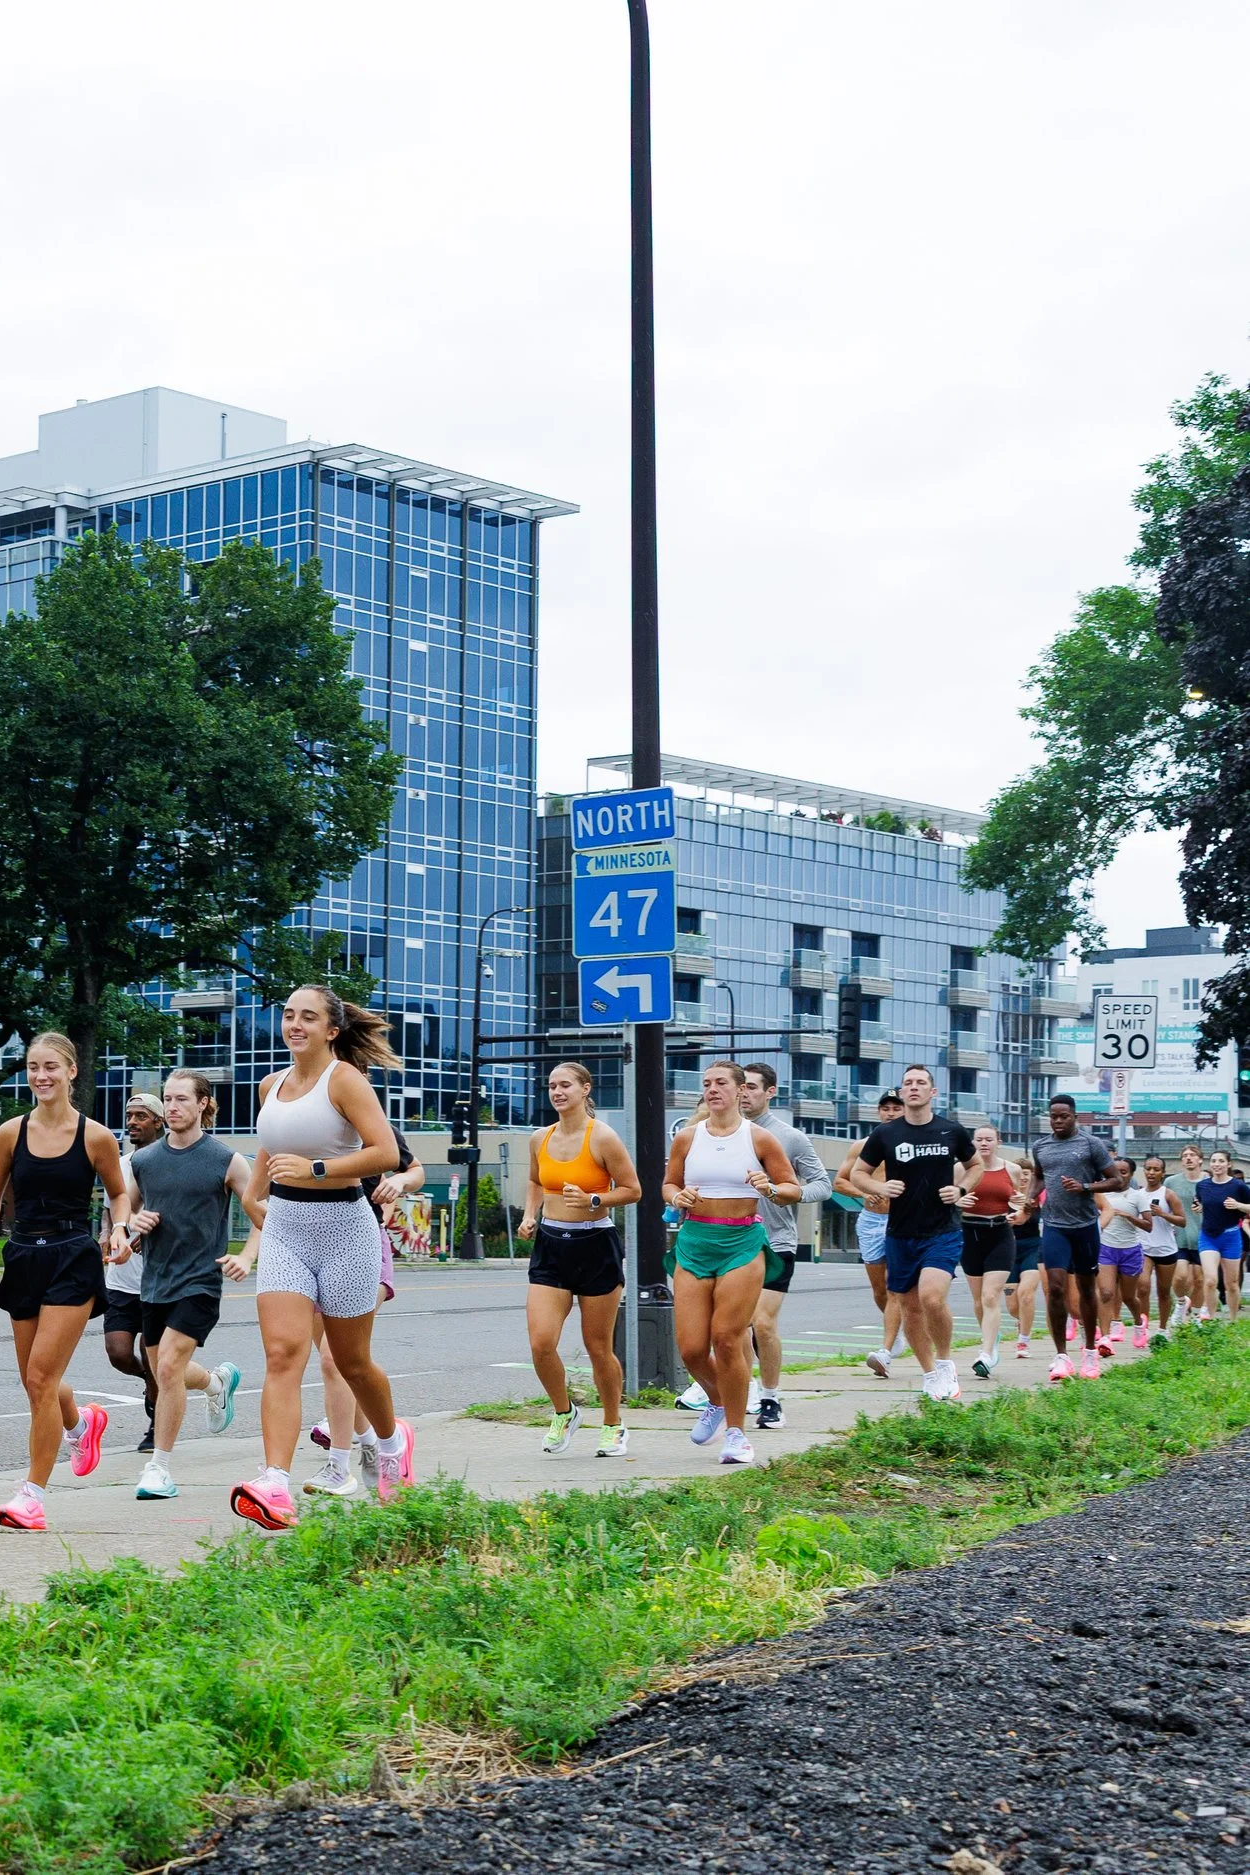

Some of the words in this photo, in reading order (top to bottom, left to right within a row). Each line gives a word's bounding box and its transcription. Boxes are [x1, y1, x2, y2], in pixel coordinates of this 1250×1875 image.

[576, 799, 671, 838] NORTH
[594, 851, 671, 870] MINNESOTA
[589, 888, 658, 937] 47
[1102, 1004, 1152, 1015] SPEED
[1106, 1019, 1146, 1029] LIMIT
[1101, 1033, 1149, 1060] 30
[915, 1146, 949, 1157] HAUS
[36, 1237, 46, 1245] alo
